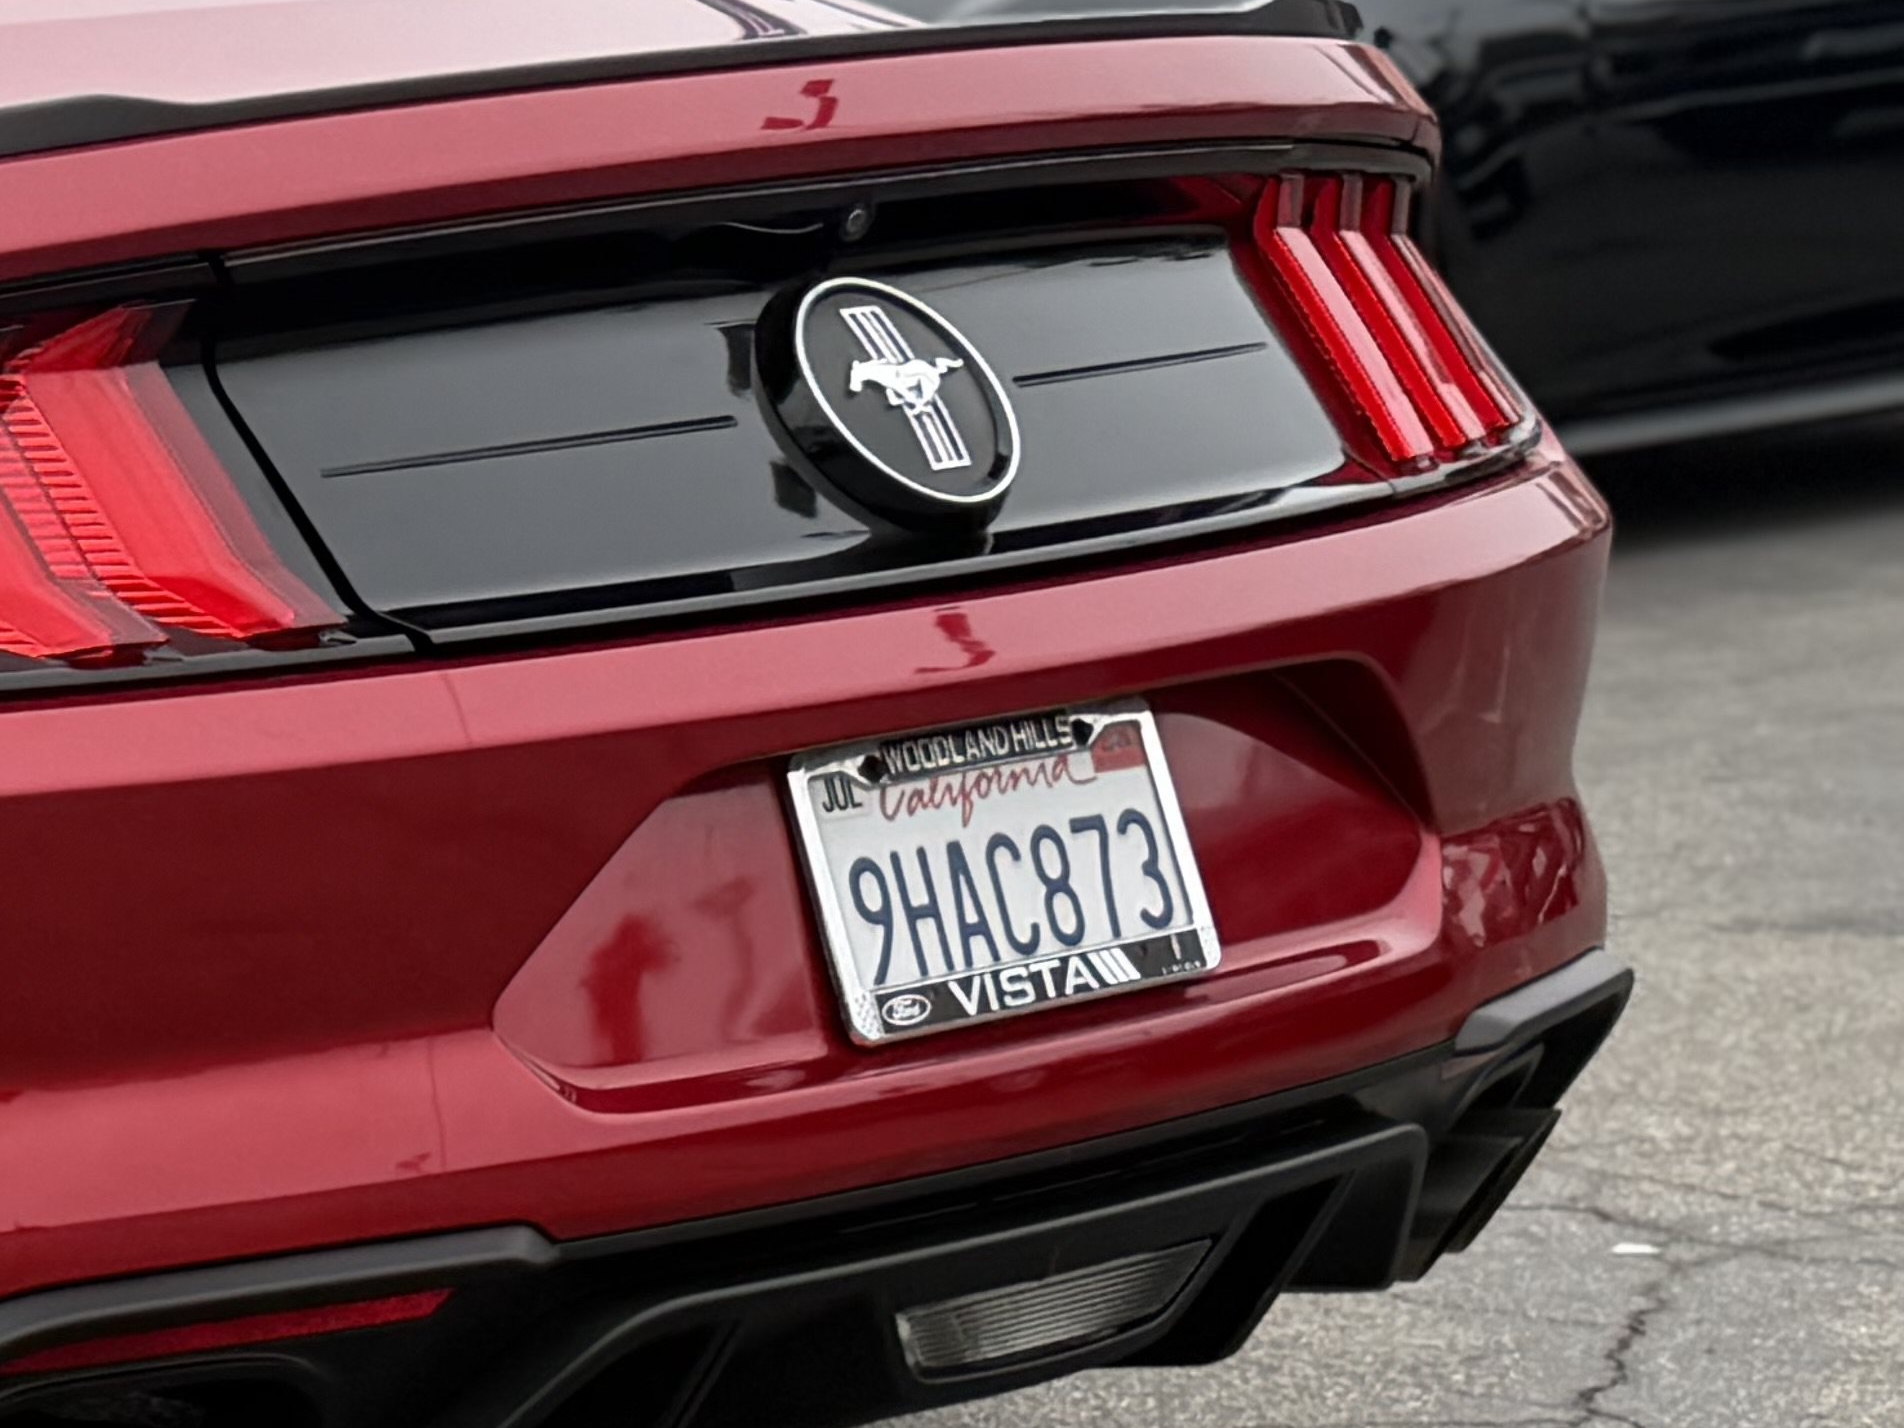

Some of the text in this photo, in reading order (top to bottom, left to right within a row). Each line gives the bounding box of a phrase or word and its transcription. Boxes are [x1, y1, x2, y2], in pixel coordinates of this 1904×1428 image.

[883, 723, 1009, 777] WOODLAND
[1013, 715, 1074, 753] HILLS
[822, 777, 863, 814] JUL
[879, 752, 1098, 828] California
[848, 807, 1174, 987] 9HAC873
[947, 955, 1100, 1017] VISTA
